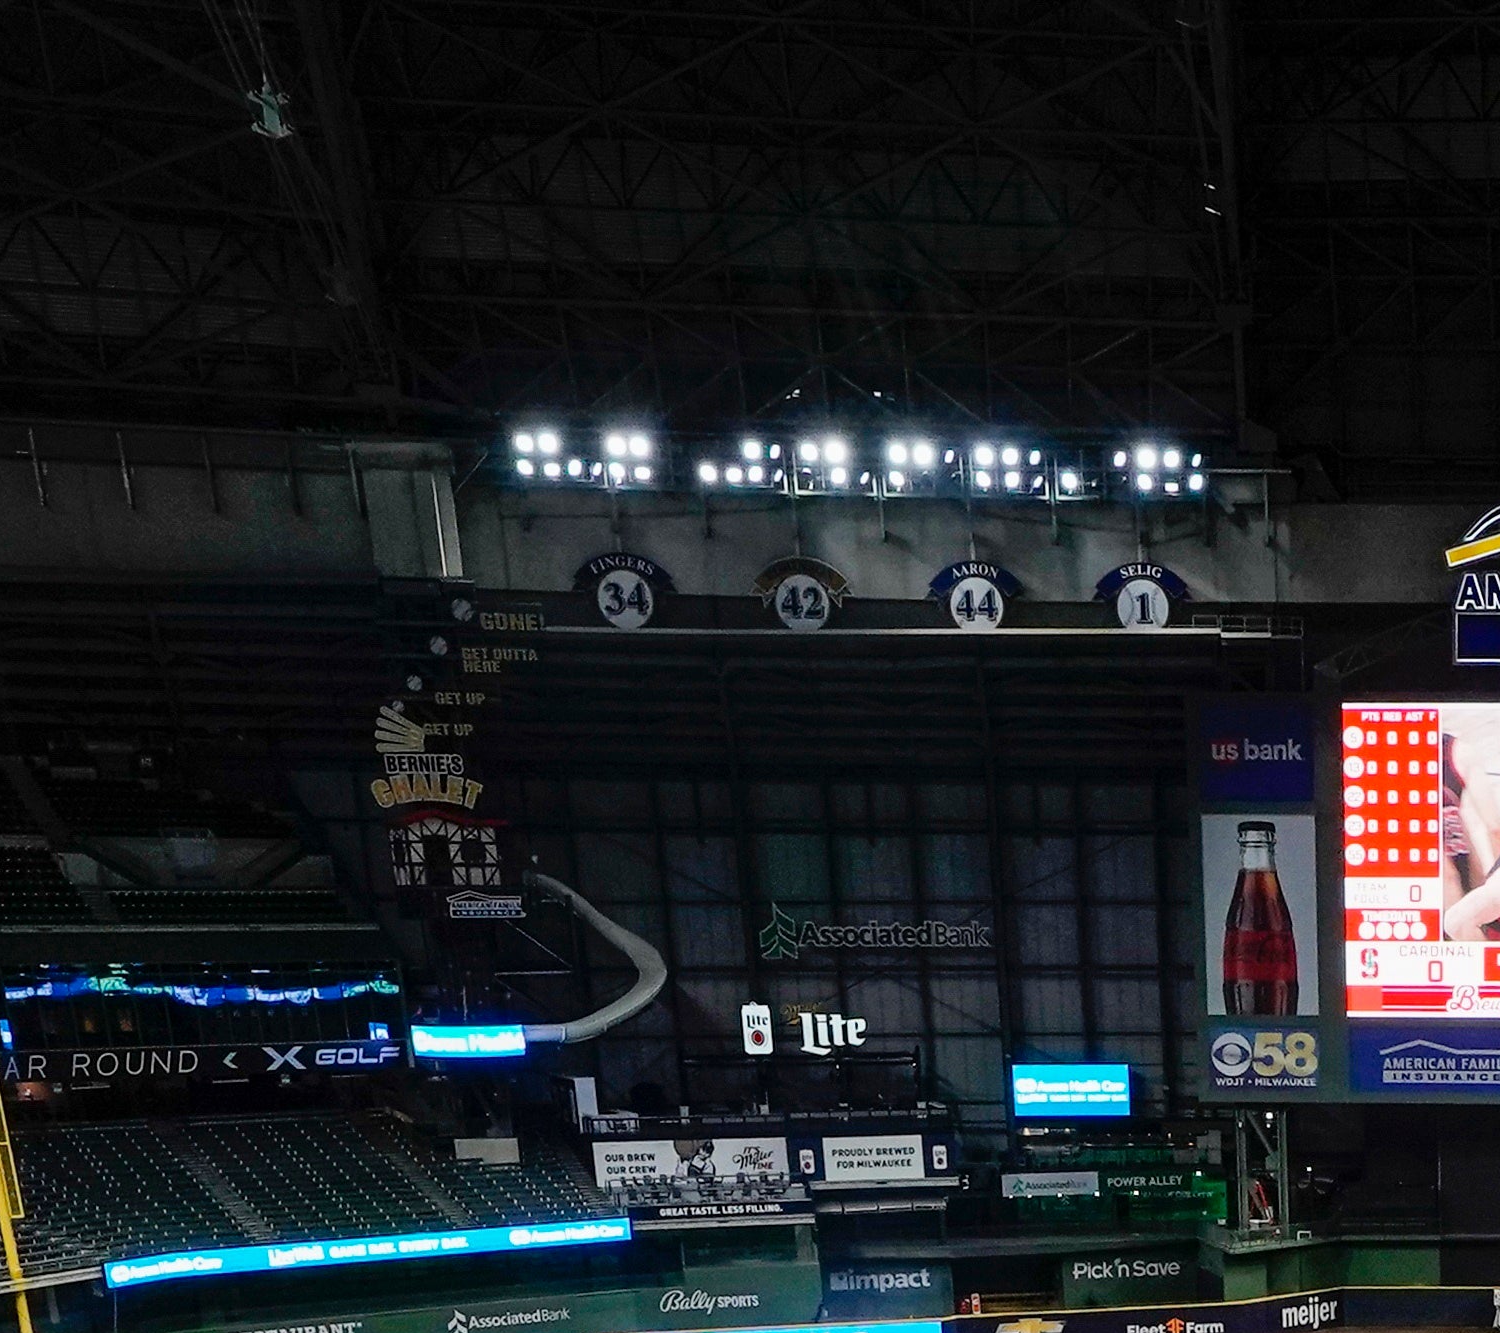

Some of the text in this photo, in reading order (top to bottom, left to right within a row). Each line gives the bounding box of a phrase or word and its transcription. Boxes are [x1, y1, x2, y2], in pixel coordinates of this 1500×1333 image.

[590, 552, 654, 576] FINGERS
[951, 564, 999, 581] AARON
[1120, 563, 1162, 580] SELIG
[603, 583, 647, 616] 34
[782, 586, 826, 619] 42
[956, 587, 998, 620] 44
[1135, 589, 1152, 622] 1
[479, 612, 545, 632] GONE!
[461, 648, 538, 662] GET OUTTA
[463, 660, 501, 674] HERE
[435, 692, 486, 706] GET UP
[423, 722, 473, 737] GET UP
[1211, 738, 1303, 761] us bank
[382, 752, 465, 775] BERNIE'S
[370, 774, 484, 811] CHALET
[1355, 882, 1421, 902] TEAM 0
[1399, 944, 1474, 957] CARDINAL
[1428, 960, 1443, 982] 0
[746, 1014, 769, 1029] Lite
[798, 1011, 868, 1057] Lite
[71, 1050, 200, 1078] ROUND
[261, 1045, 402, 1072] X GOLF
[1251, 1032, 1319, 1078] 58
[1383, 1056, 1457, 1071] AMERICAN
[1215, 1076, 1318, 1087] WDJT MILWAUKEE
[1392, 1071, 1500, 1082] INSURANCE
[605, 1153, 656, 1163] OUR BREW
[832, 1146, 915, 1158] PROUDLY BREWED
[606, 1165, 657, 1175] OUR CREW
[836, 1158, 912, 1169] FOR MILWAUKEE
[1107, 1174, 1183, 1188] POWER ALLEY
[659, 1204, 783, 1217] GREAT TASTE. LESS FILLING.
[849, 1267, 931, 1293] impact
[659, 1289, 759, 1315] Bally SPORTS
[1282, 1296, 1338, 1329] meijer
